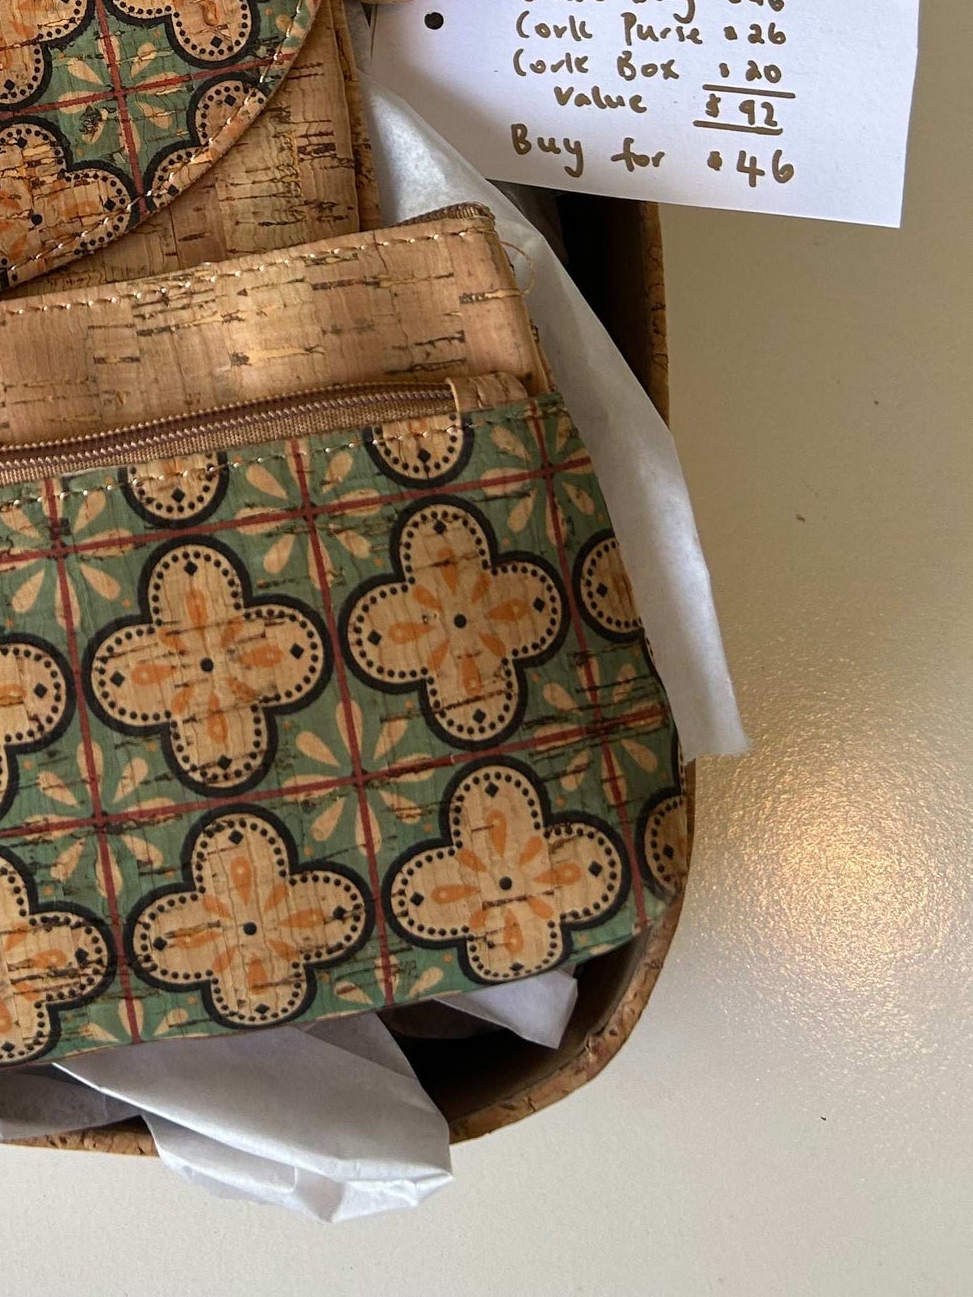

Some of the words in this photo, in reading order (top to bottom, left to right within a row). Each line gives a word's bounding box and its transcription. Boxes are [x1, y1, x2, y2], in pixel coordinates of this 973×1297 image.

[515, 10, 593, 42] Cork
[620, 11, 703, 47] Purse
[512, 48, 589, 77] Cork
[616, 50, 680, 82] Box
[510, 123, 585, 178] Buy
[610, 137, 666, 173] for
